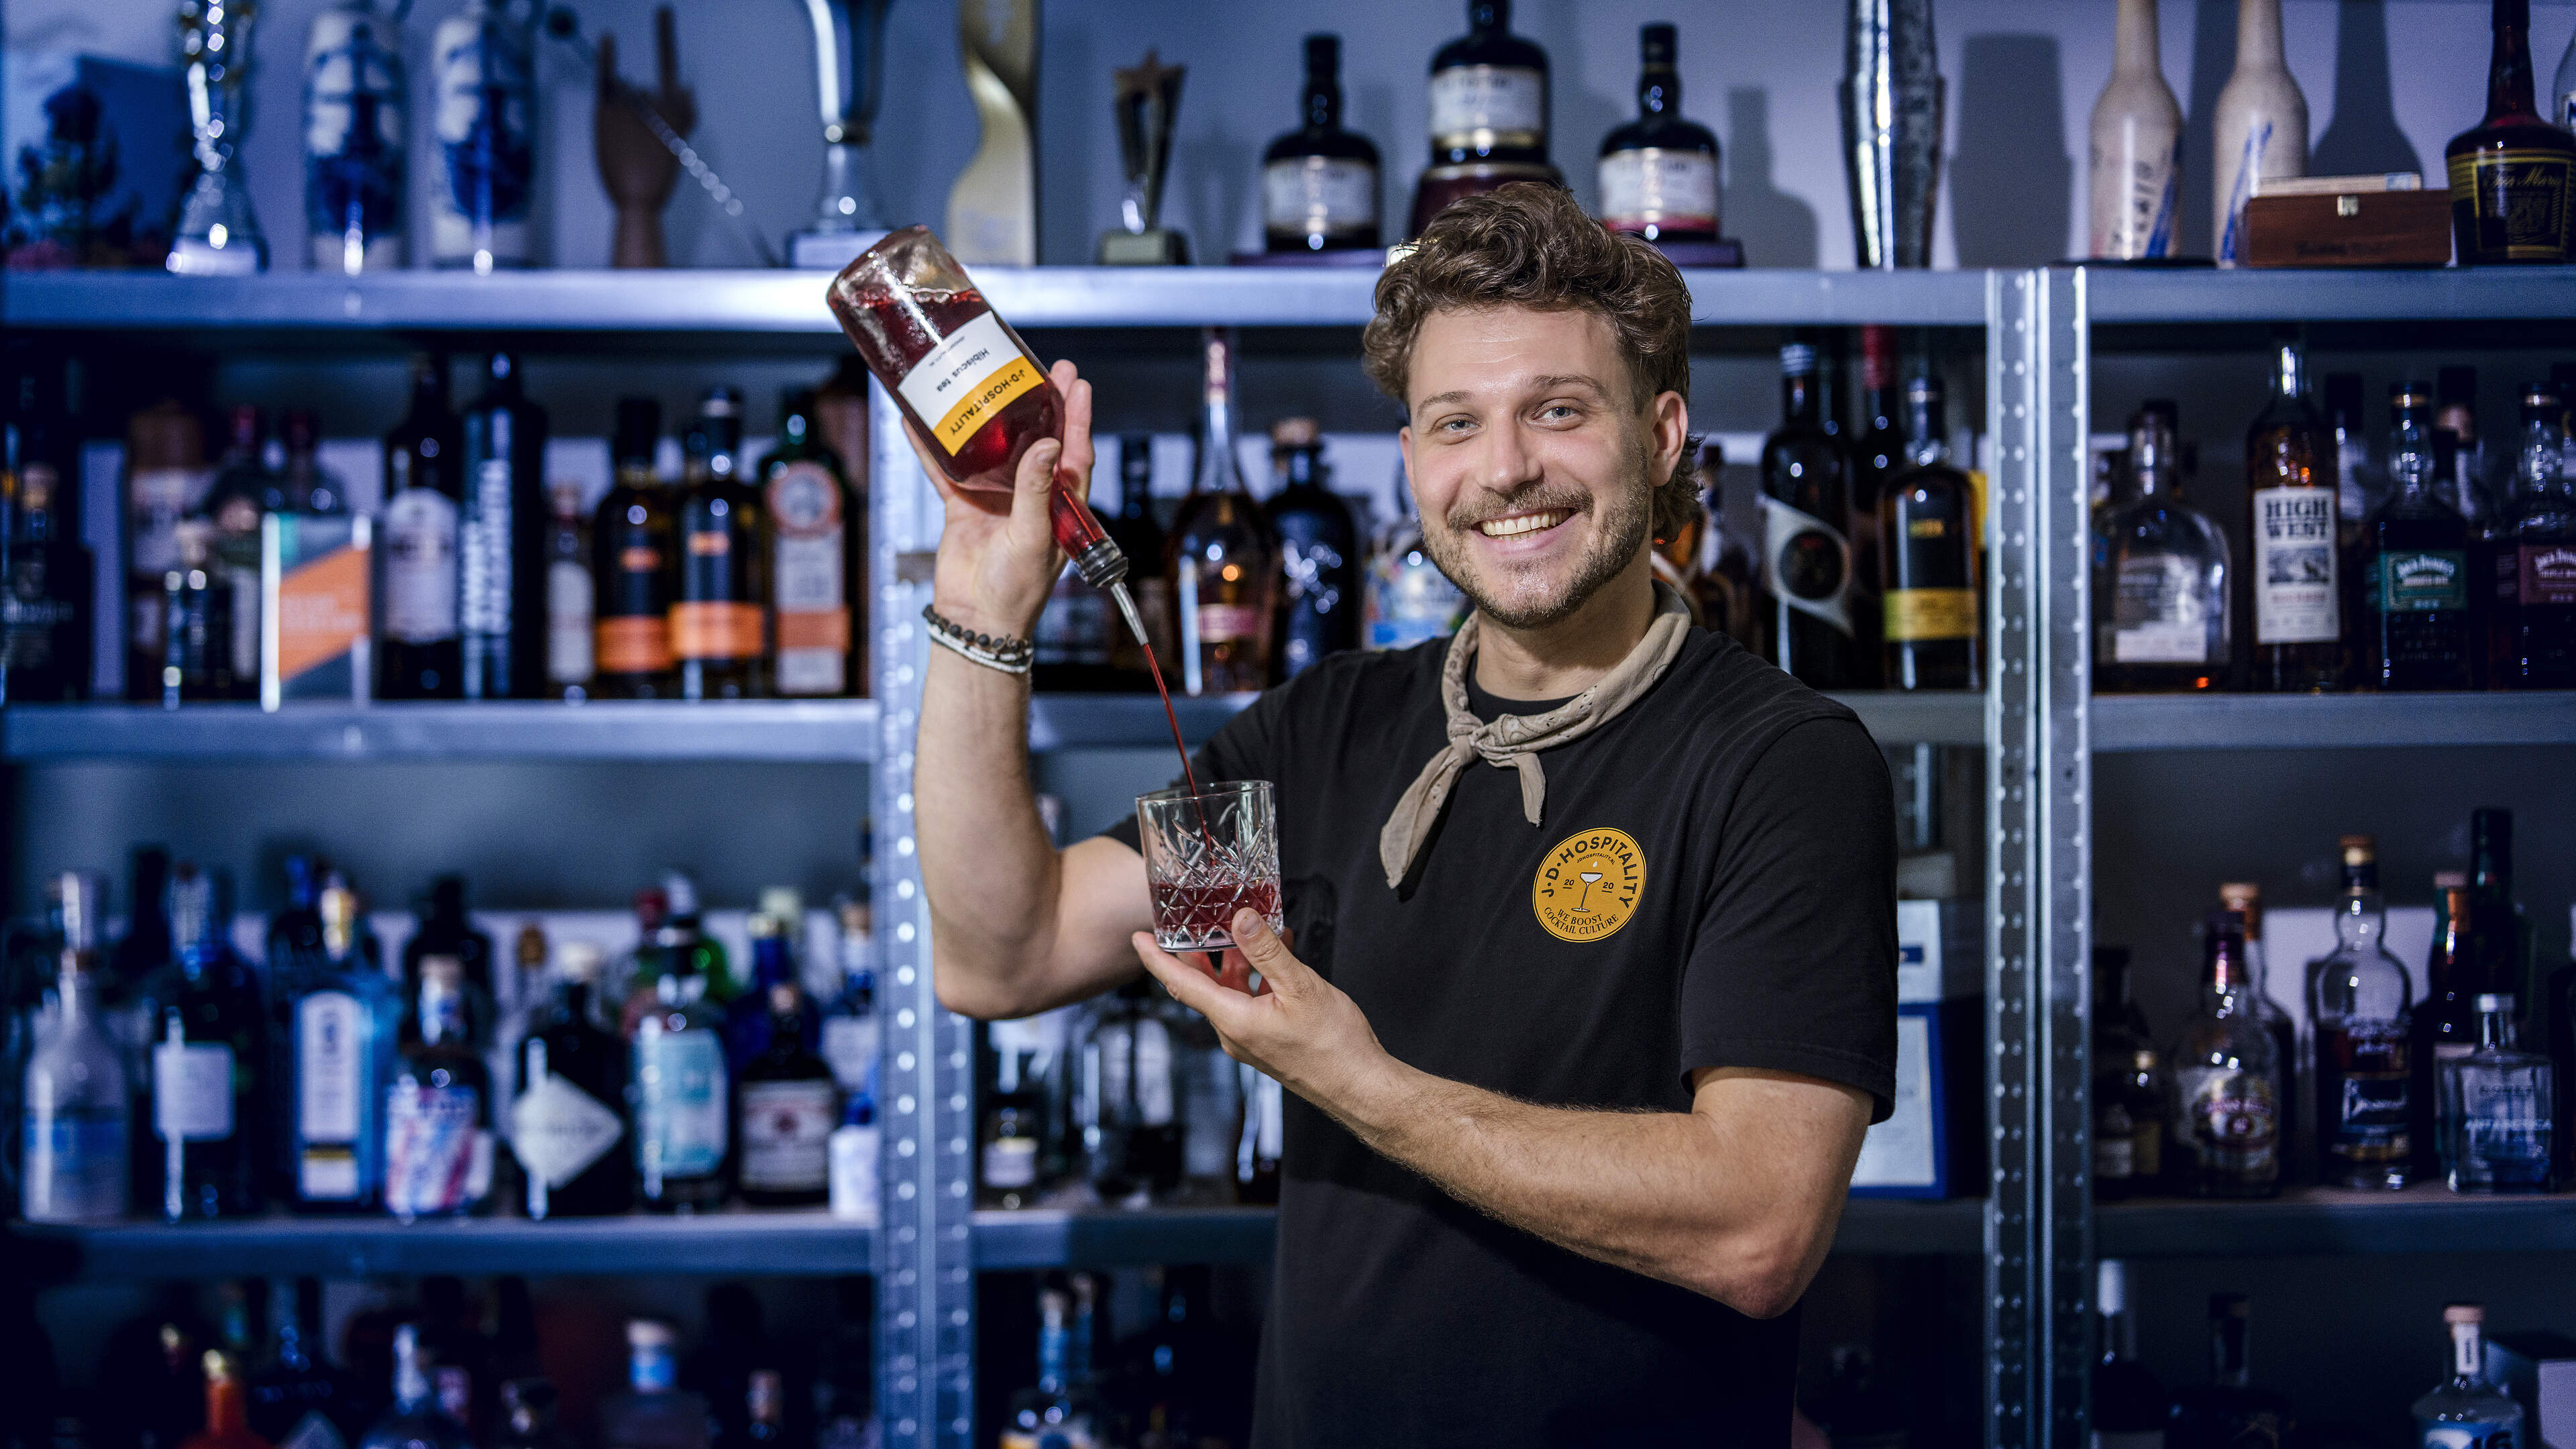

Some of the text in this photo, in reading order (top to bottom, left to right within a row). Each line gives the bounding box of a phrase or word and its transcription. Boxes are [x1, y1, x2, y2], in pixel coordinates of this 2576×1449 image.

[952, 347, 990, 378] Hibiscus
[936, 378, 951, 392] tea
[2266, 498, 2327, 517] HIGH
[2267, 521, 2327, 537] WEST
[1576, 853, 1615, 865] JDHOSPITALITY.NL
[1603, 881, 1614, 890] 20
[1544, 907, 1619, 934] COCKTAIL CULTURE
[1557, 908, 1602, 926] WE BOOST
